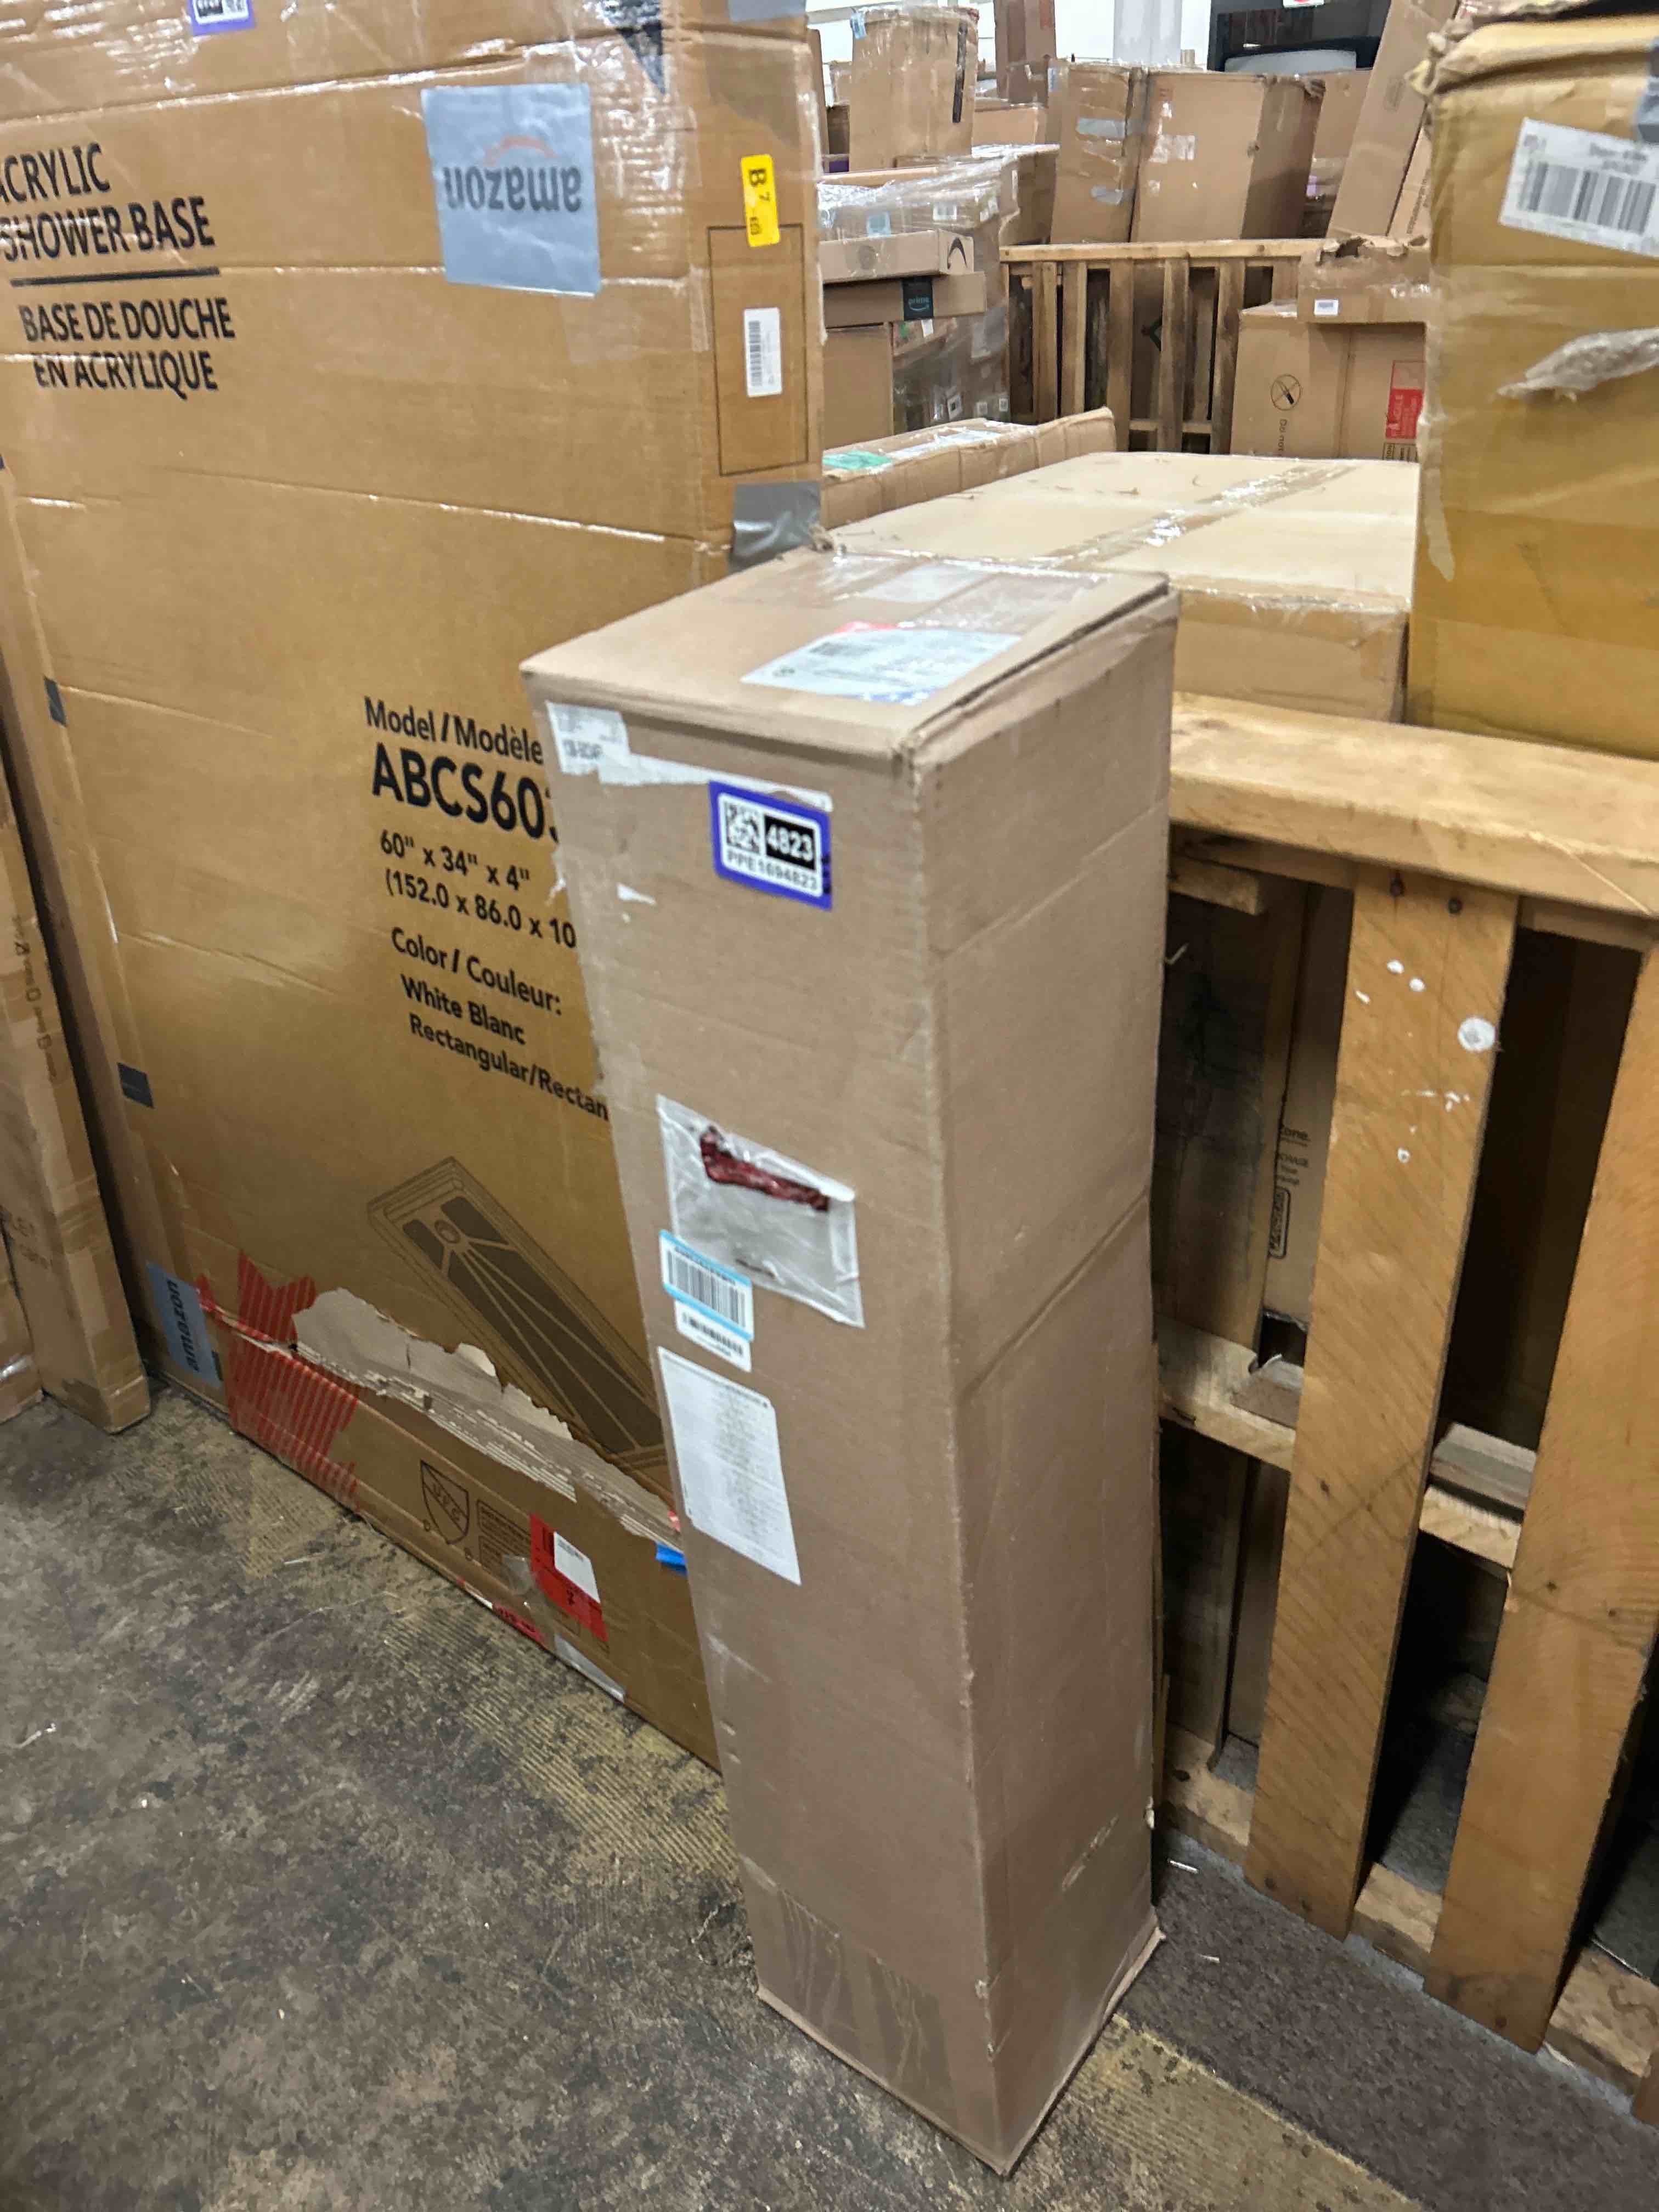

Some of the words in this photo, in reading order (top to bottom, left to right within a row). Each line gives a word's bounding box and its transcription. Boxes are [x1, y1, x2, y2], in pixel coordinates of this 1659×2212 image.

[444, 166, 583, 213] amazon
[0, 205, 131, 261] SHOWER
[128, 195, 216, 251] BASE
[18, 302, 84, 342] BASE
[83, 301, 120, 341] DE
[119, 297, 235, 340] DOUCHE
[908, 297, 930, 306] prime
[32, 353, 69, 388] EN
[74, 351, 219, 400] ACRYLIQUE
[364, 696, 437, 742] Model
[453, 715, 544, 765] Modèle
[423, 845, 435, 867] x
[488, 864, 500, 887] x
[768, 824, 814, 862] 4823
[385, 868, 450, 909] (152.0
[456, 893, 469, 916] x
[475, 894, 522, 932] 86.0
[529, 916, 543, 939] x
[390, 927, 448, 973] Color
[466, 955, 562, 1016] Couleur:
[400, 973, 463, 1020] White
[468, 1000, 527, 1046] Blanc
[166, 1277, 200, 1373] amazon
